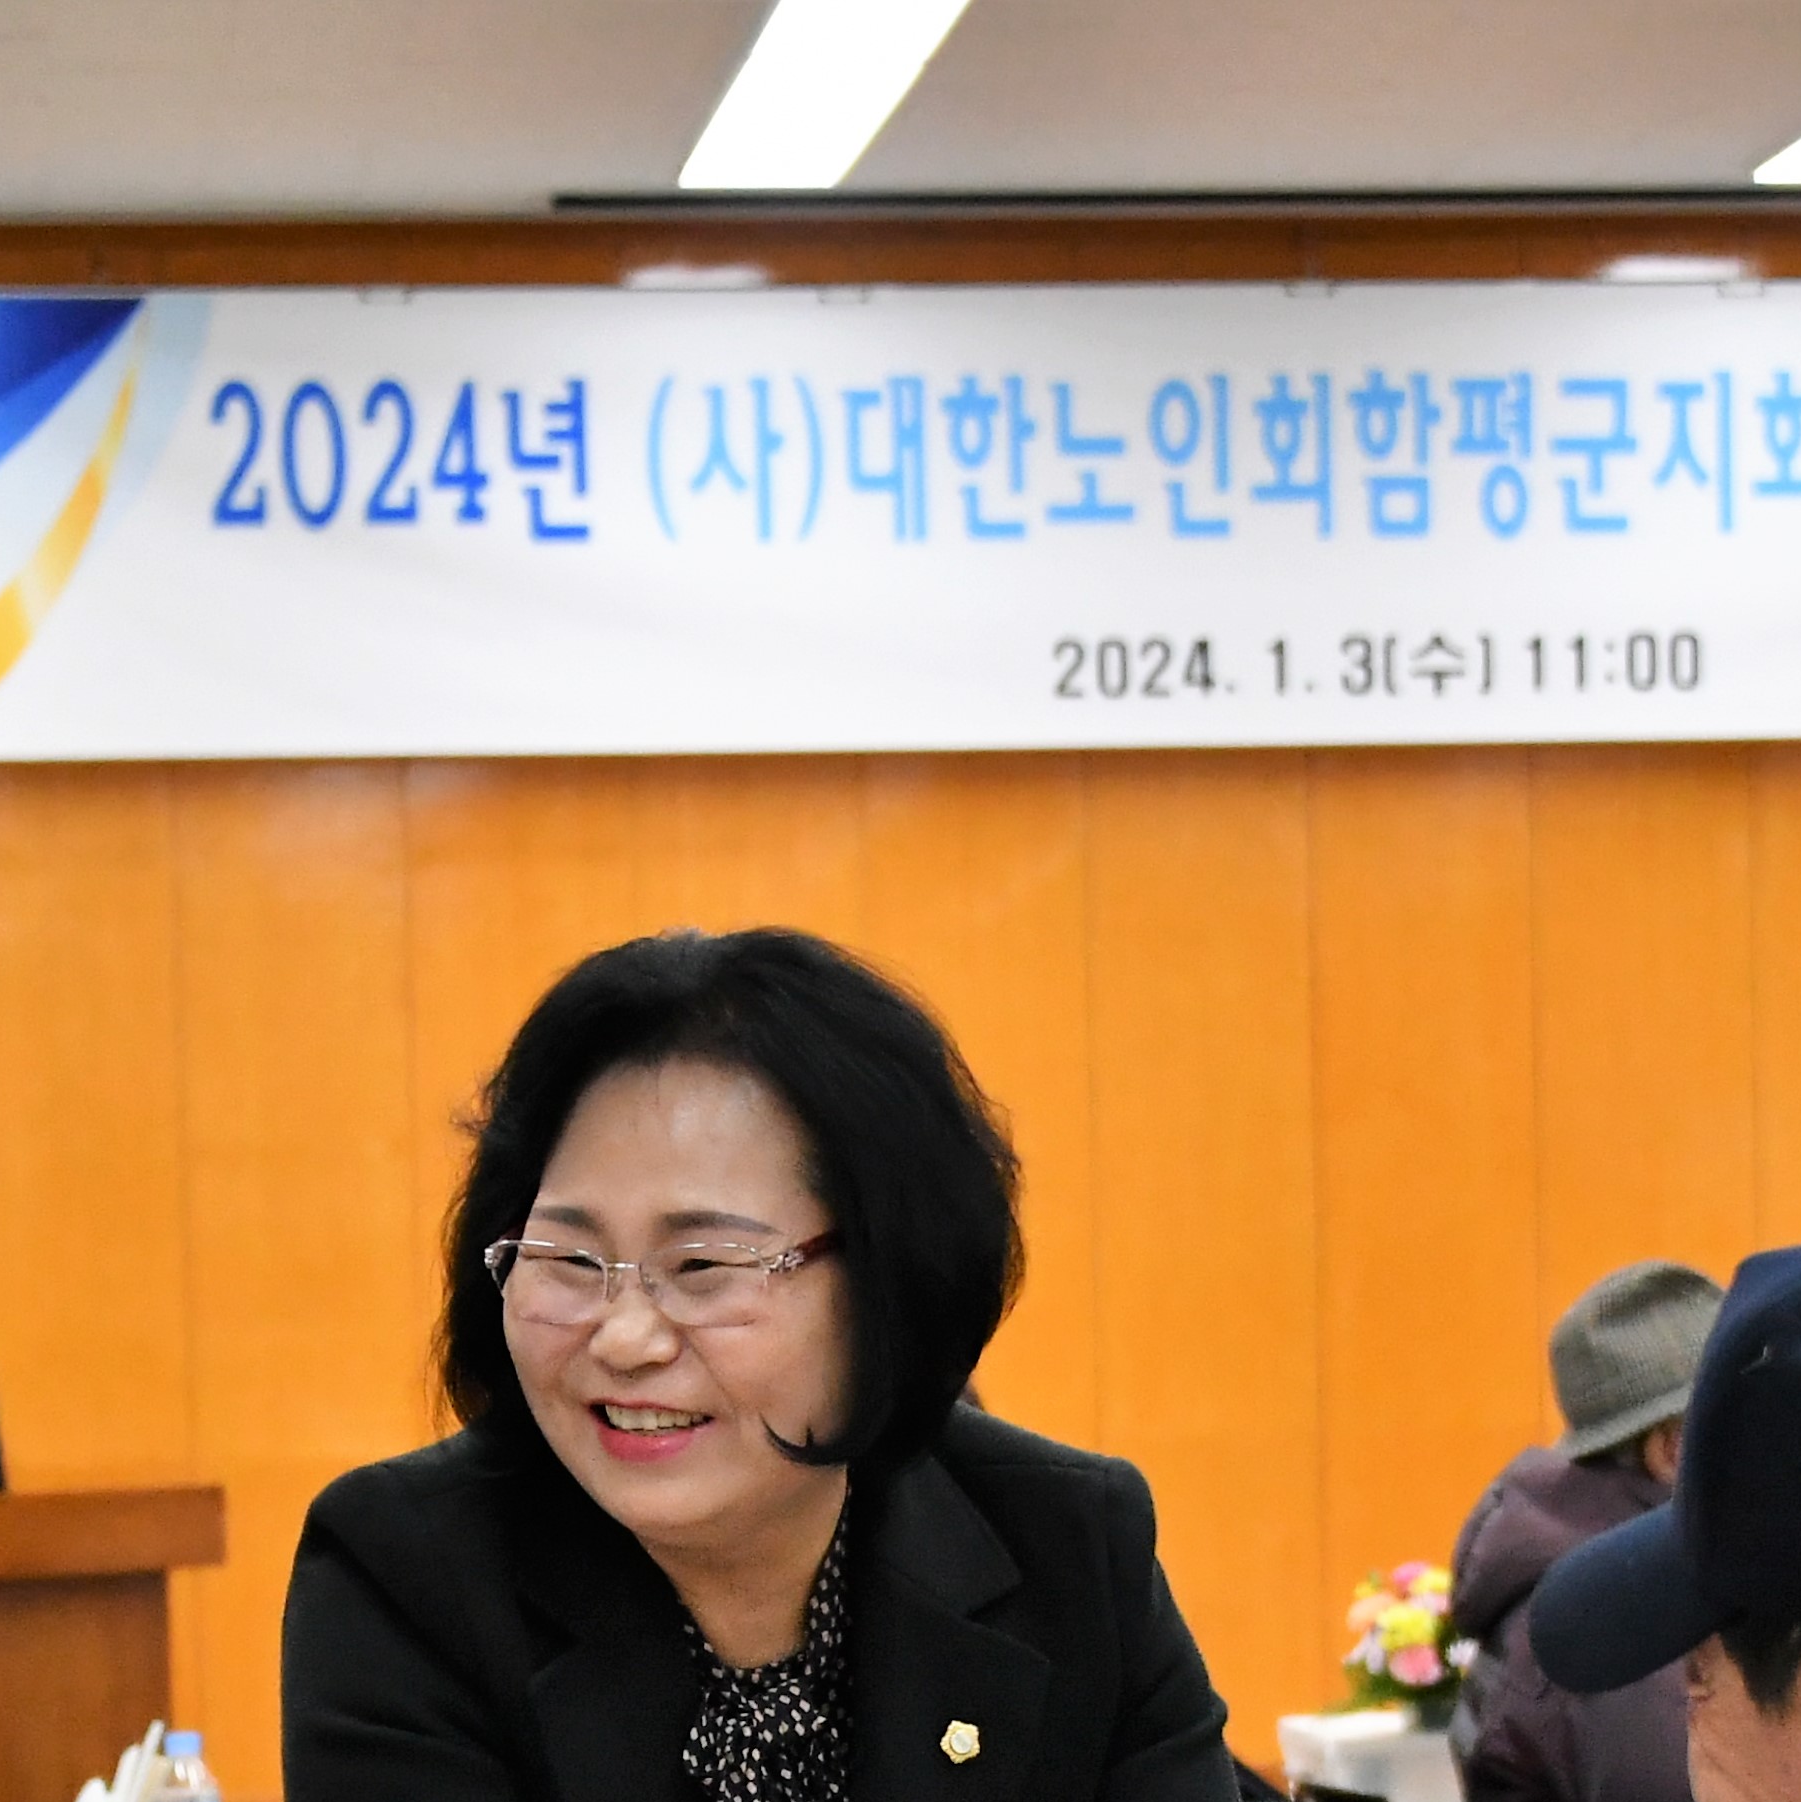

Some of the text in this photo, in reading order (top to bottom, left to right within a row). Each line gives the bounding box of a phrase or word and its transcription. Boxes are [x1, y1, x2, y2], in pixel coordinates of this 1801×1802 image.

[209, 376, 594, 546] 2024년
[1052, 631, 1702, 699] 2024. 1. 3(수) 11:00
